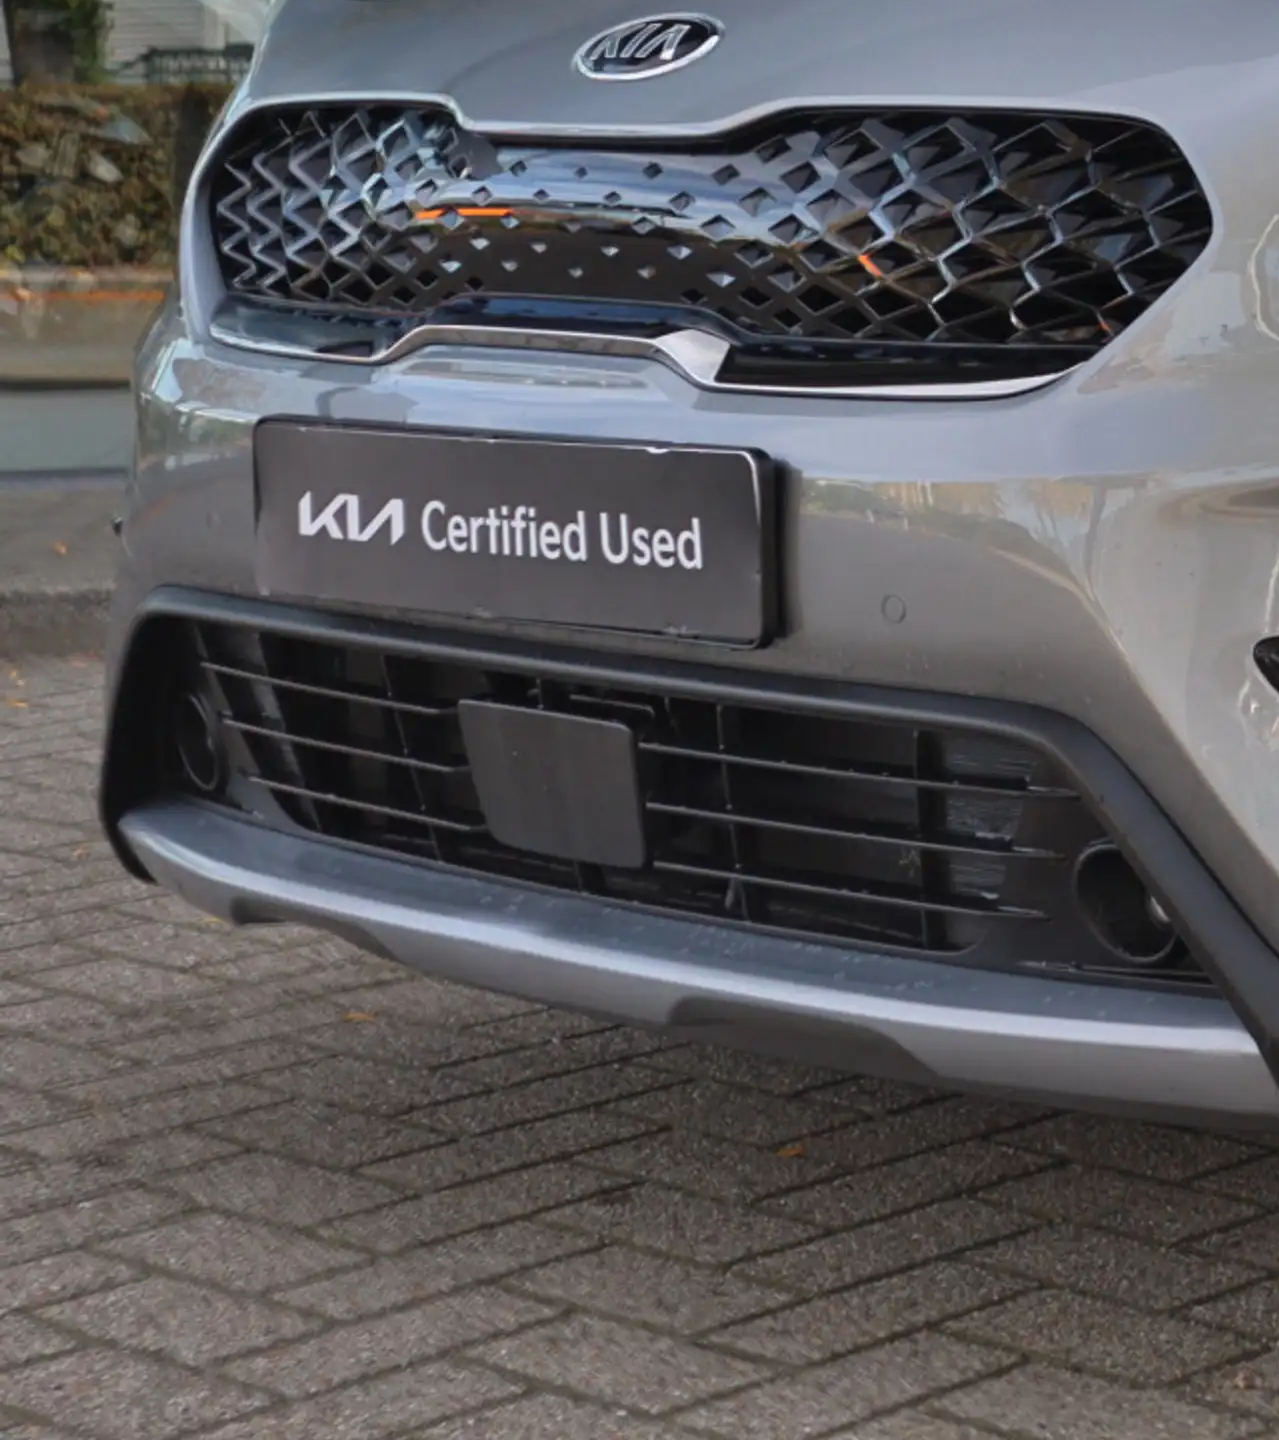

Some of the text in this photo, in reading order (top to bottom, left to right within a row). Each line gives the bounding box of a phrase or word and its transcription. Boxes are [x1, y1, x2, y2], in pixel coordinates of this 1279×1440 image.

[588, 22, 692, 61] KIA
[298, 490, 703, 571] KIA Certified Used
